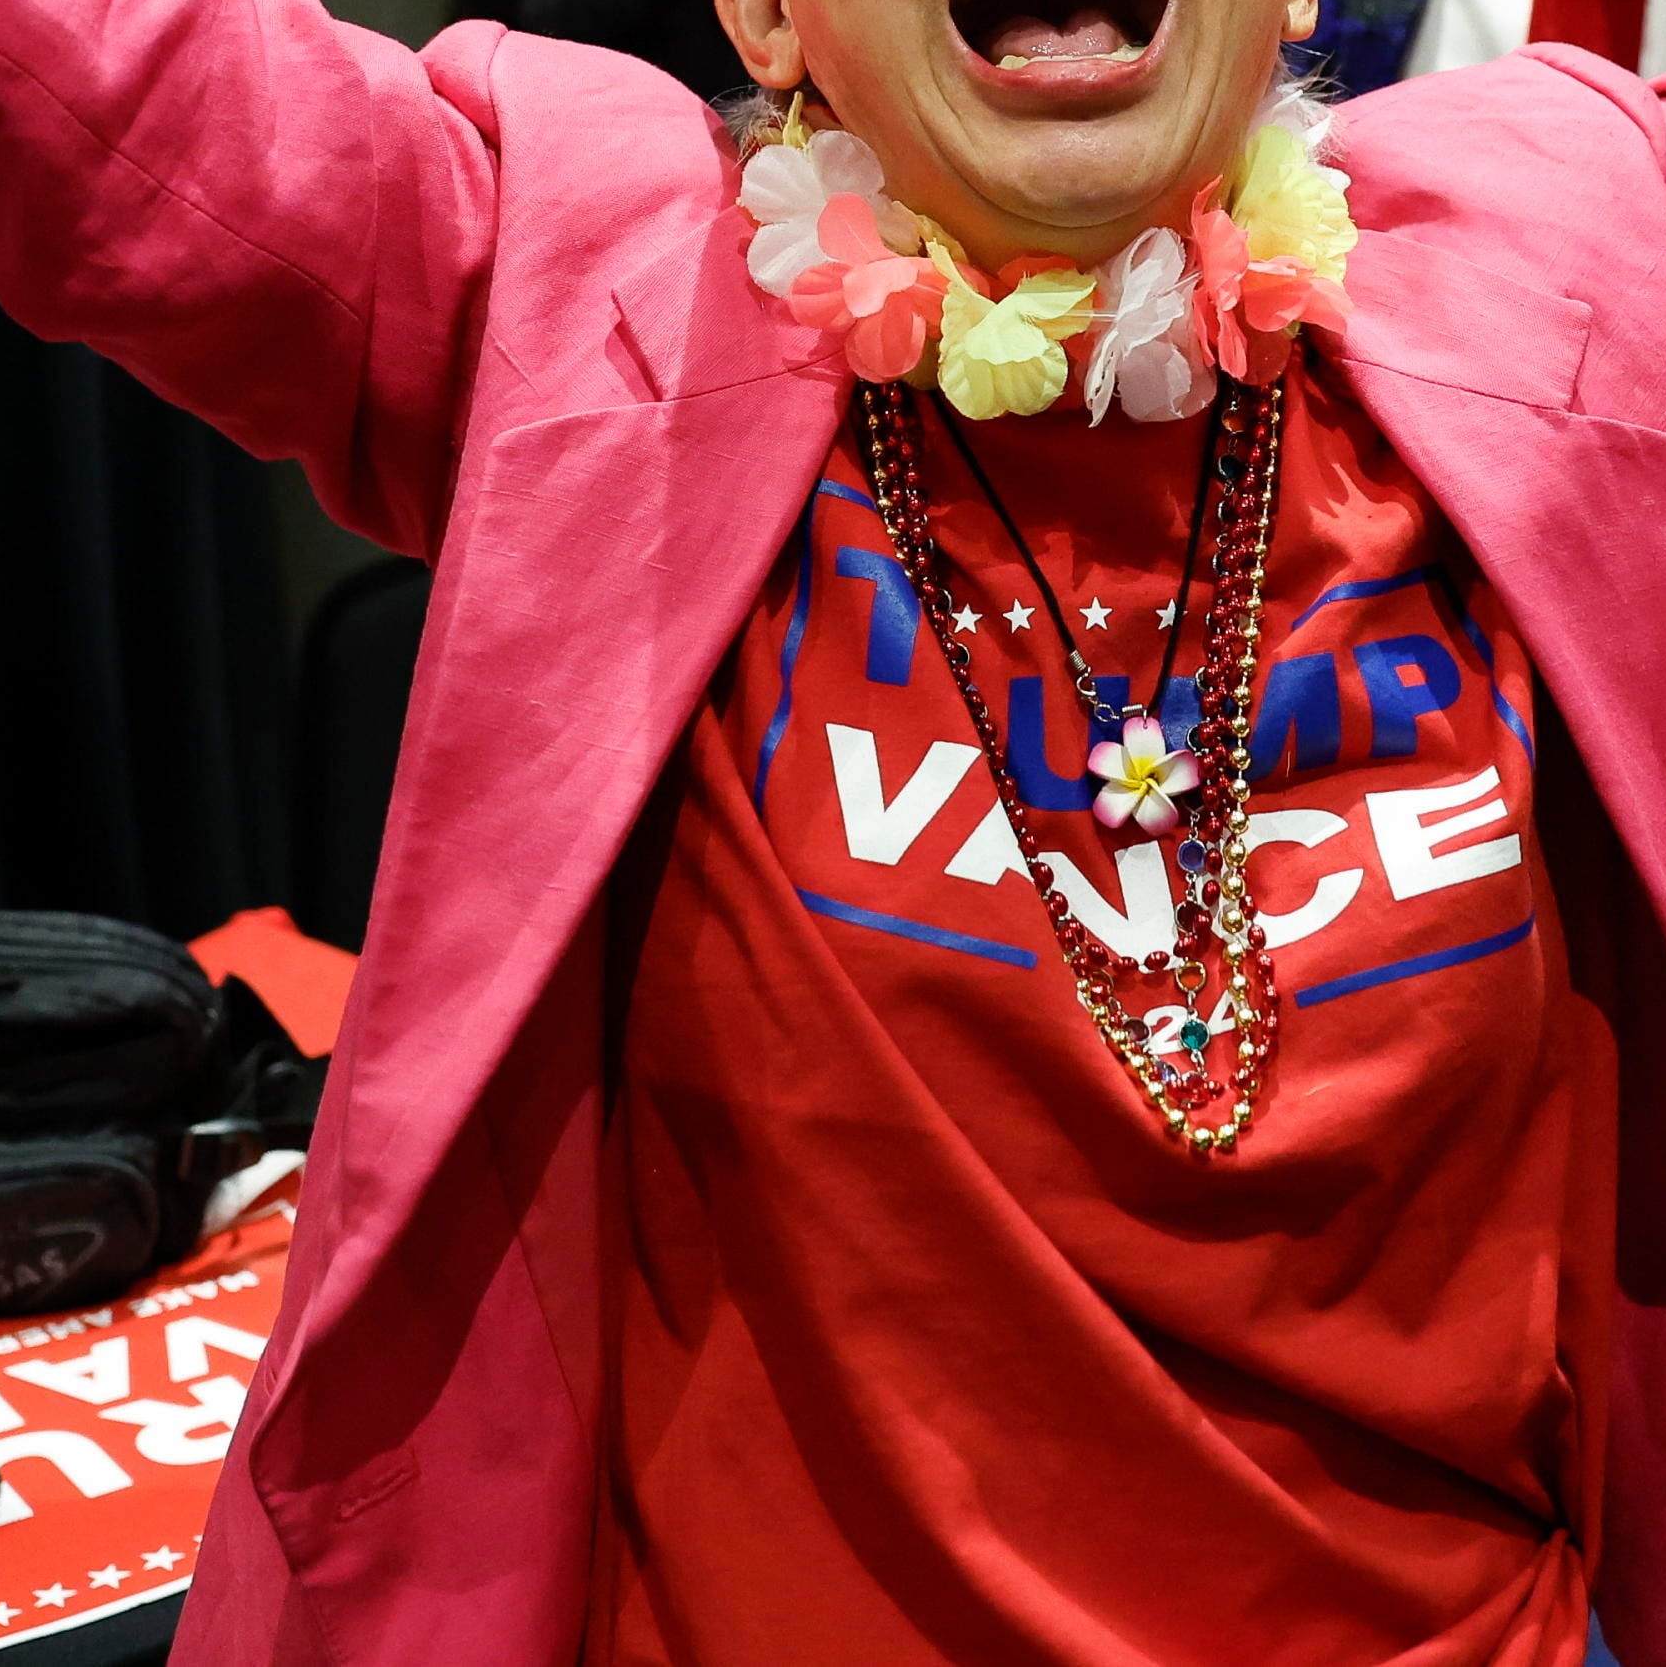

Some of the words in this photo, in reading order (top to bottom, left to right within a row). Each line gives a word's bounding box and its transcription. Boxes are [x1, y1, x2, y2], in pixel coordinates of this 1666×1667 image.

[836, 546, 1462, 812] TUMP
[825, 720, 1523, 974] VANCE
[129, 1270, 259, 1318] MAKE
